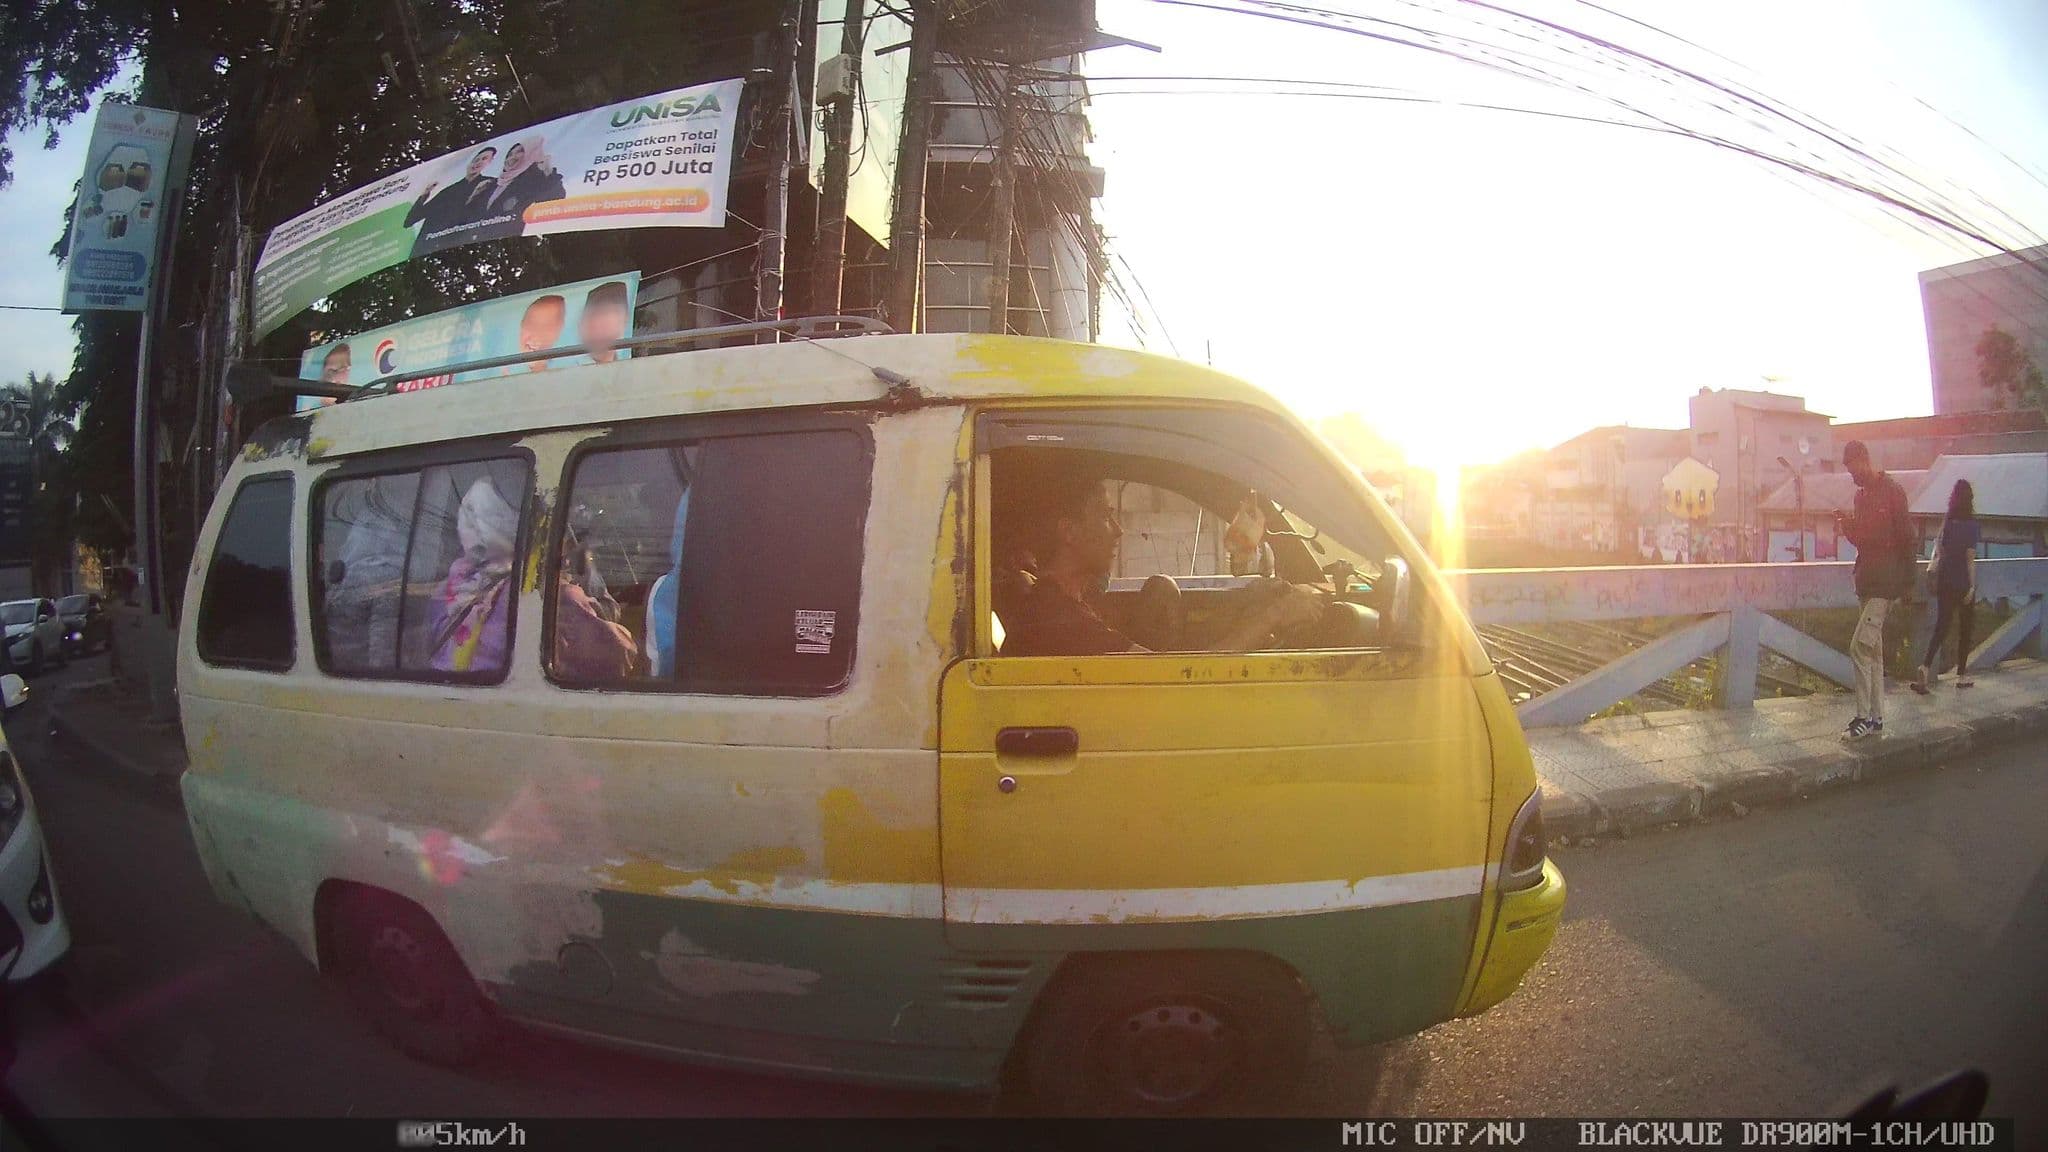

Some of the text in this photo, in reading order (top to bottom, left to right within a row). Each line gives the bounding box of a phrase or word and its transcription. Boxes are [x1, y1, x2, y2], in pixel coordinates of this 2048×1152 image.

[605, 129, 717, 151] Dapatkan Total
[593, 142, 716, 165] Beasiswa Senilai
[583, 158, 713, 186] Rp 500 Juta
[533, 196, 698, 220] pmb.unisa-bandung.ac.id
